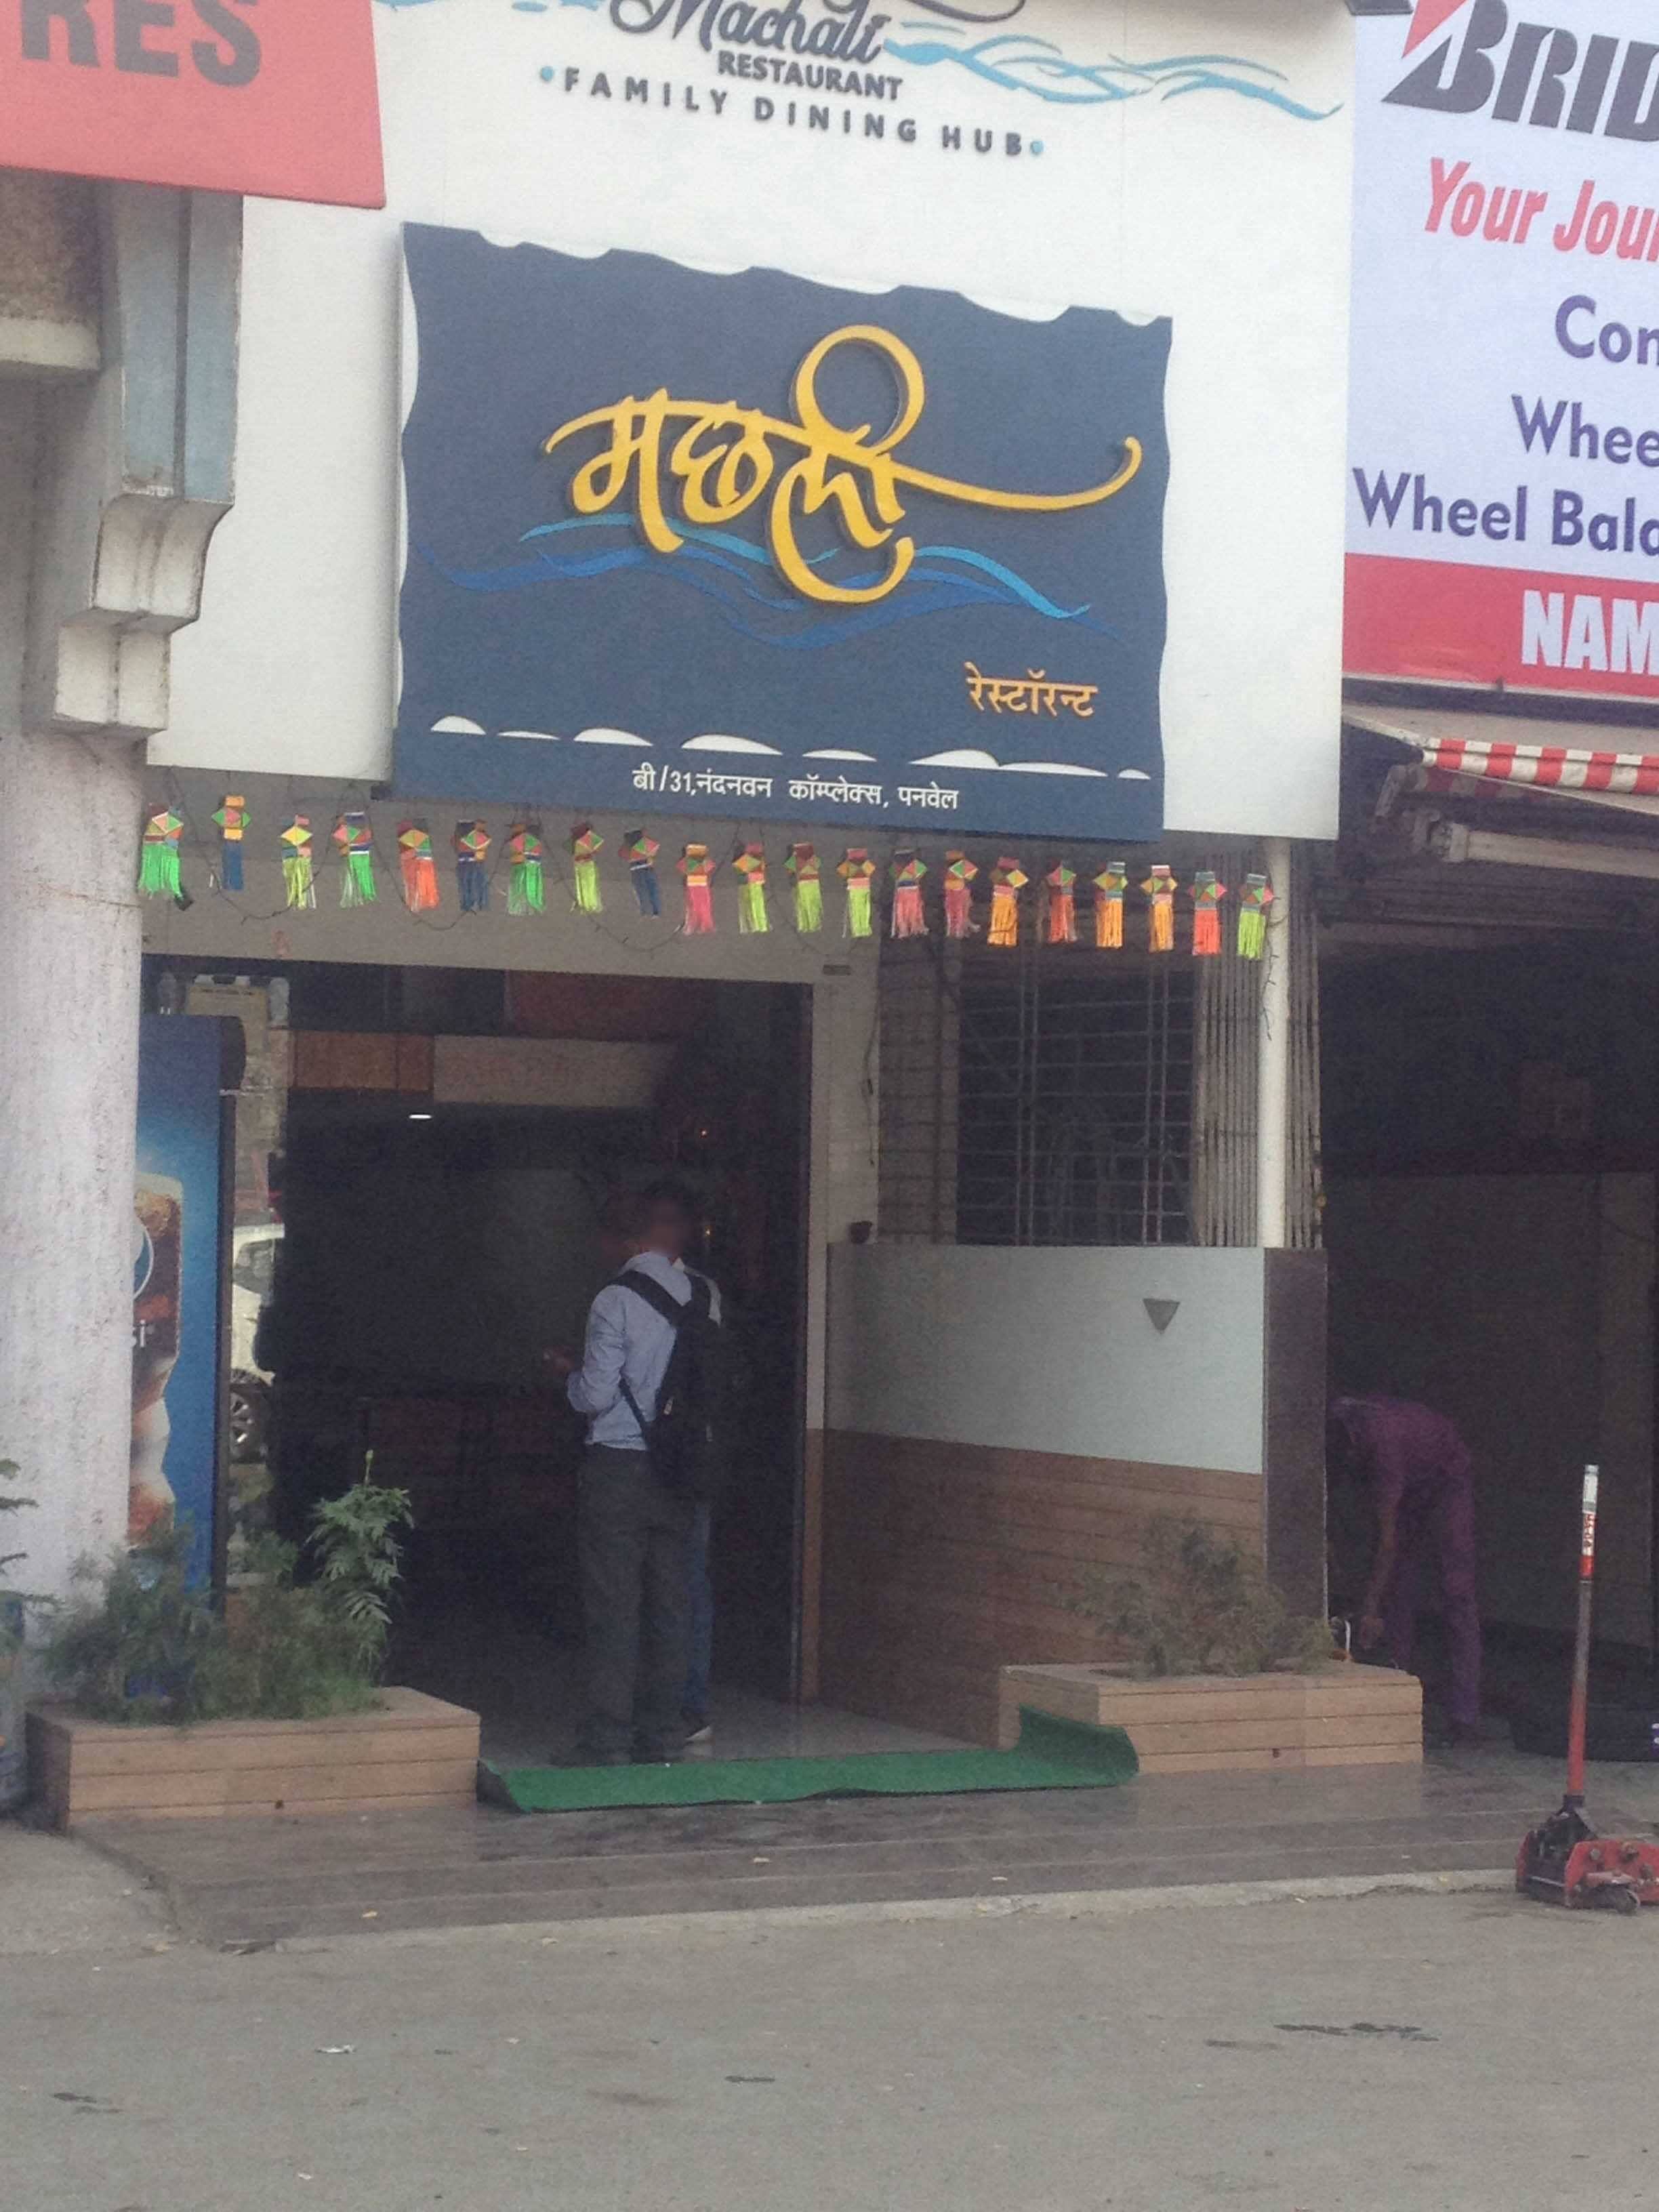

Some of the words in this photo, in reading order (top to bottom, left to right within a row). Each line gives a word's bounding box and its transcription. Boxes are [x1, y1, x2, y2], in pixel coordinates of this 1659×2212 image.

[564, 66, 727, 115] FAMILY
[754, 96, 917, 143] DINING
[941, 125, 1023, 157] HUB
[717, 50, 903, 101] RESTAURANT
[1424, 157, 1549, 244] Your
[544, 324, 1143, 604] मछली
[1511, 394, 1659, 468] Whee
[1352, 467, 1527, 541] Wheel
[964, 661, 1099, 717] रेस्टॉरन्ट
[897, 781, 959, 809] पनवेल
